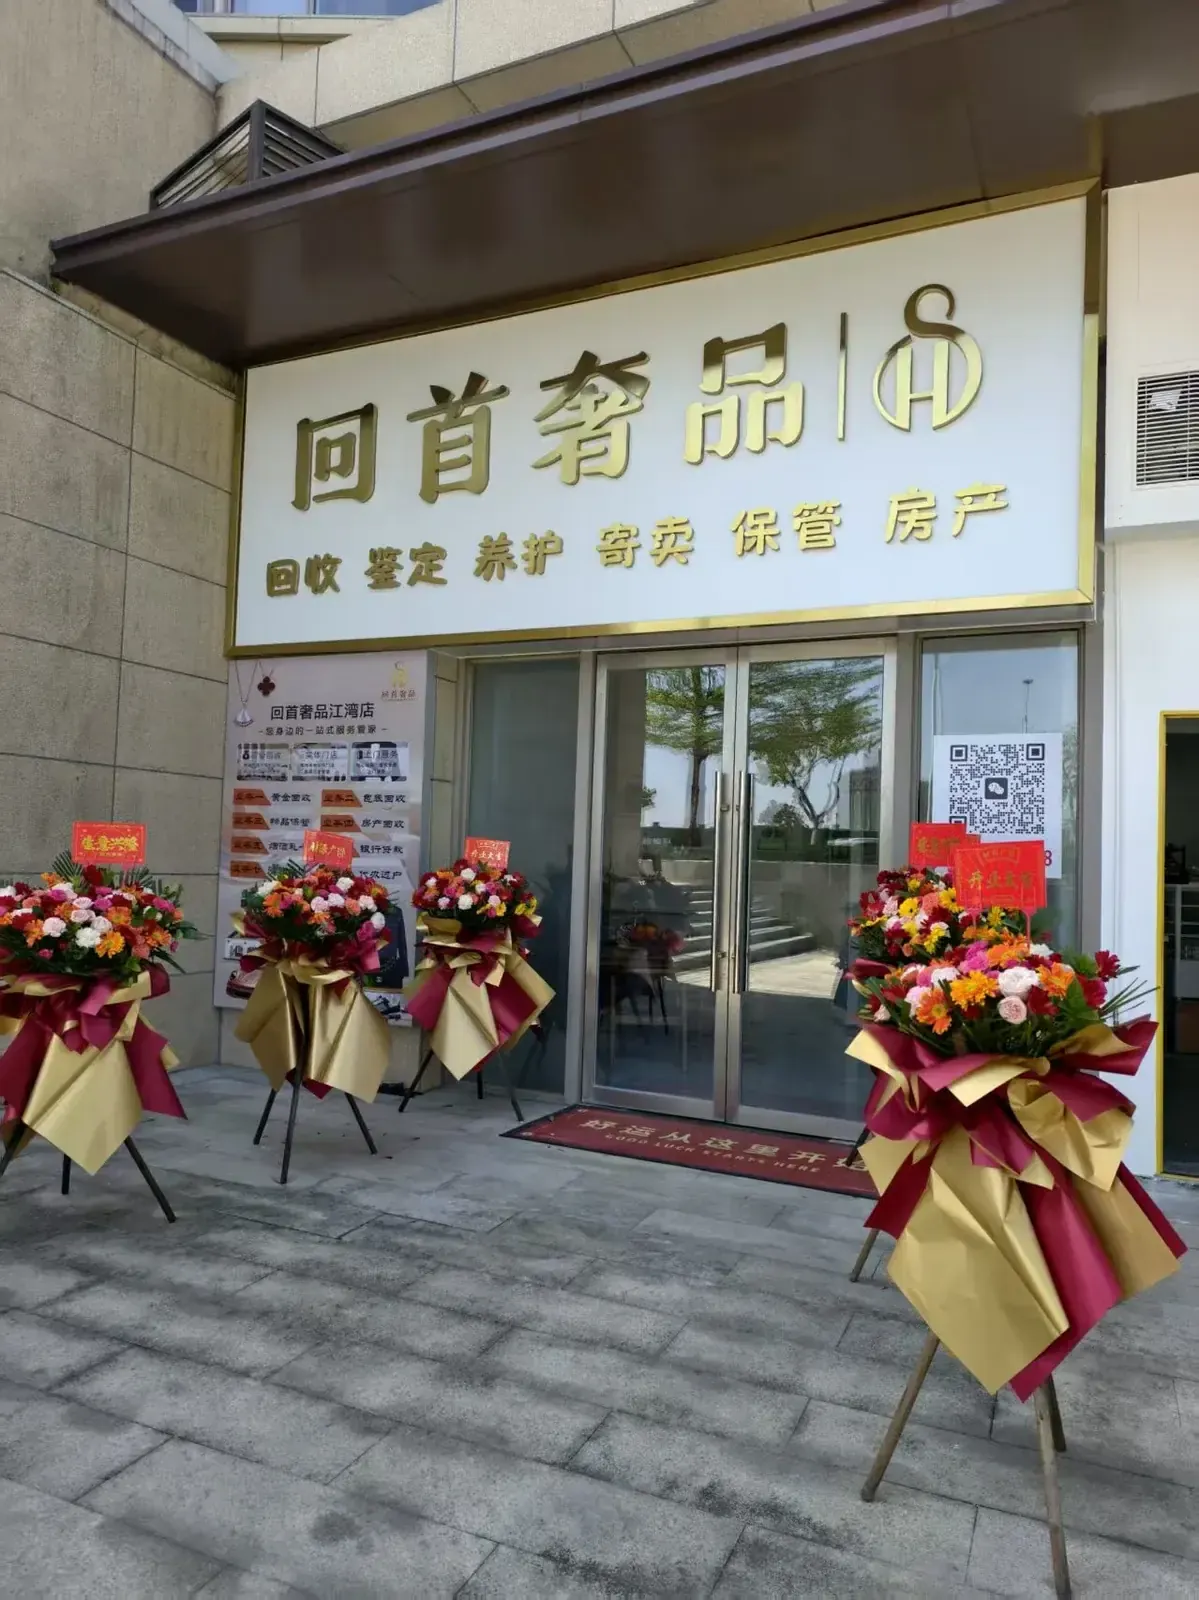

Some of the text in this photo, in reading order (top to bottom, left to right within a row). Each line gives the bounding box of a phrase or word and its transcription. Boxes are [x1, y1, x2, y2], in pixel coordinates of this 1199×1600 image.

[291, 322, 803, 512] 回首奢品
[265, 481, 1011, 597] 回收 鉴定 养护 寄卖 保管 房产
[270, 702, 375, 721] 回首奢品江湾店
[361, 818, 405, 829] 房产回收
[773, 1160, 821, 1173] HERE
